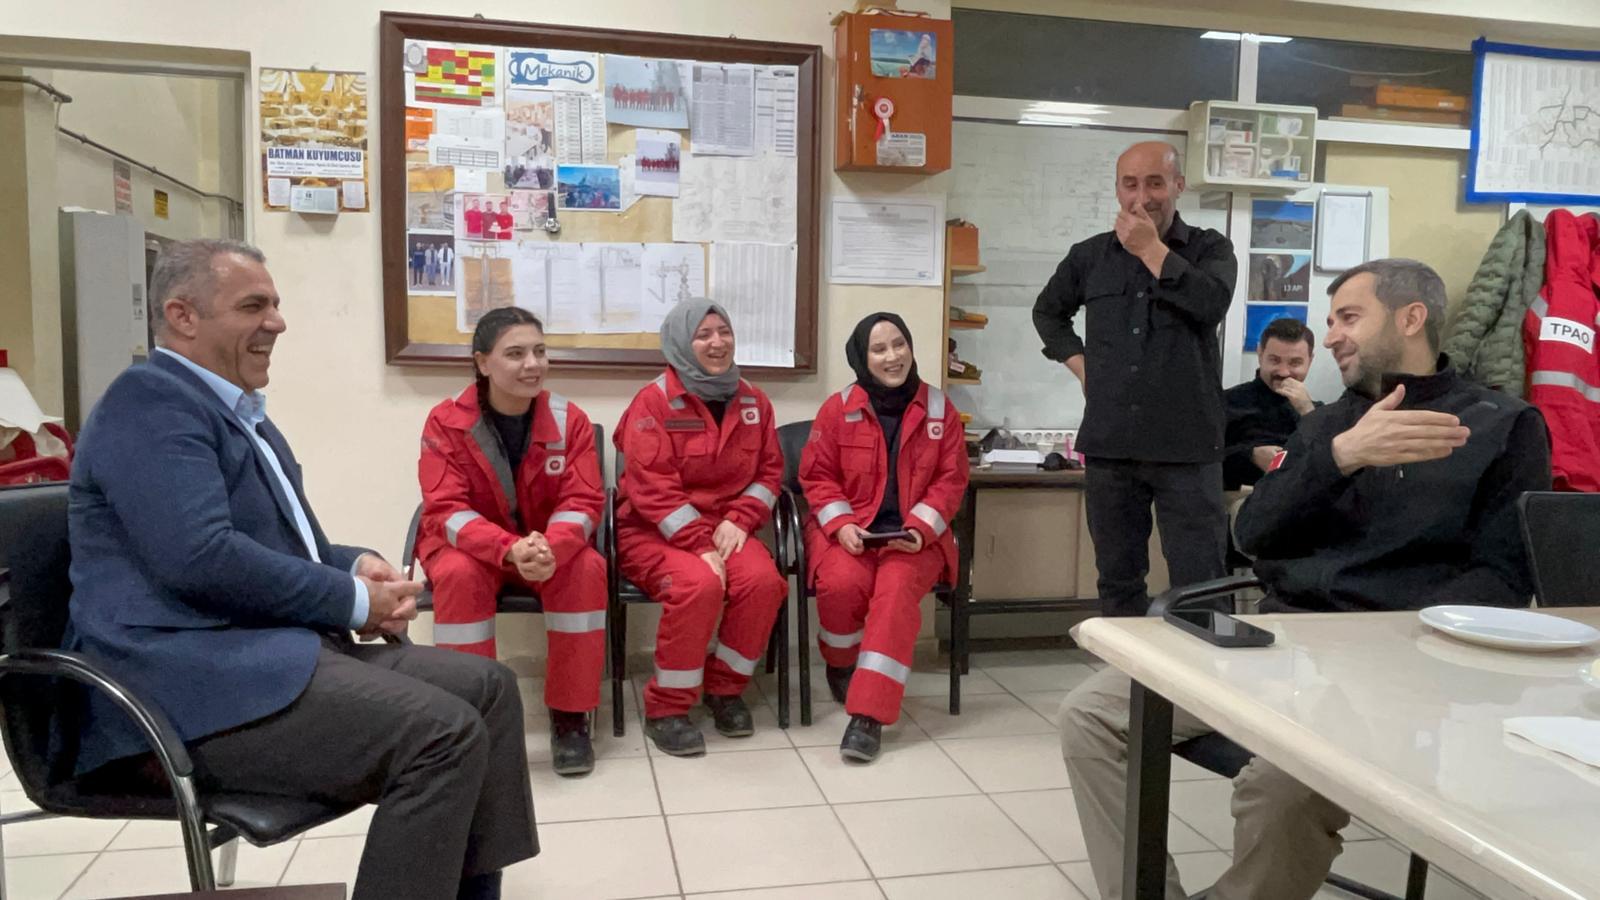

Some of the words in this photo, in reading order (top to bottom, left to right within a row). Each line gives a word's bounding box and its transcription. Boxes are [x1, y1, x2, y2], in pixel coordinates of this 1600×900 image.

[524, 63, 584, 80] Mekanik
[268, 148, 305, 160] BATMAN
[306, 149, 362, 162] KUYUMCUSU
[1550, 322, 1590, 345] TPAO
